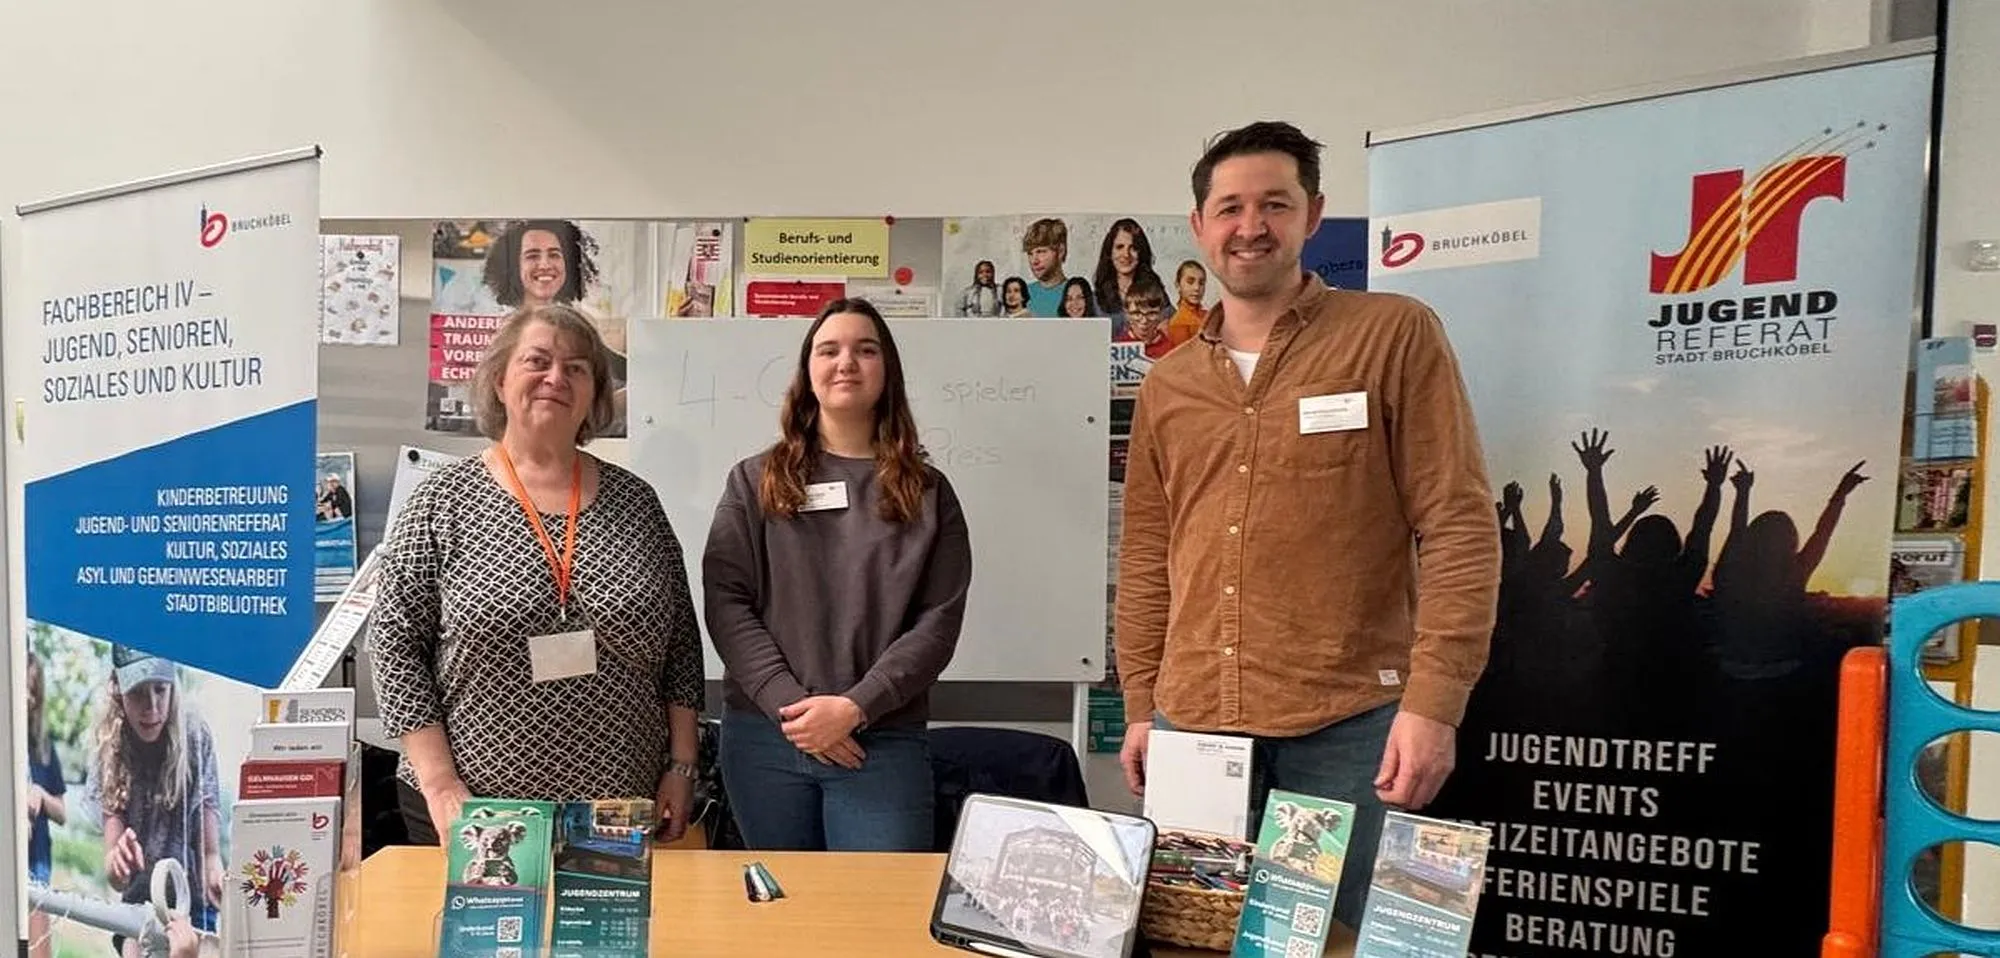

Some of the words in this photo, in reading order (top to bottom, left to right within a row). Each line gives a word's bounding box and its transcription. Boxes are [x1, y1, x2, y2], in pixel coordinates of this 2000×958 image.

[232, 214, 292, 232] BRUCHKÖBEL
[779, 232, 825, 244] Berufs-
[828, 232, 853, 244] und
[1432, 230, 1528, 251] BRUCHKÖBEL
[751, 252, 880, 267] Studienorientierung
[42, 285, 168, 326] FACHBEREICH
[175, 280, 195, 308] IV
[1648, 290, 1838, 328] JUGEND
[43, 332, 122, 363] JUGEND,
[127, 318, 234, 355] SENIOREN,
[1657, 316, 1838, 351] REFERAT
[1655, 352, 1709, 365] STADT
[1712, 342, 1833, 362] BRUCHKÖBEL
[44, 370, 128, 404] SOZIALES
[134, 366, 176, 396] UND
[182, 357, 263, 391] KULTUR
[943, 376, 1036, 404] spielen
[157, 486, 288, 507] KINDERBETREUUNG
[75, 516, 128, 534] JUGEND-
[132, 516, 159, 533] UND
[164, 513, 288, 533] SENIORENREFERAT
[166, 541, 218, 561] KULTUR,
[221, 541, 288, 559] SOZIALES
[77, 568, 107, 584] ASYL
[110, 568, 135, 584] UND
[138, 568, 288, 587] GEMEINWESENARBEIT
[166, 594, 288, 615] STADTBIBLIOTHEK
[1484, 732, 1718, 774] JUGENDTREFF
[1533, 780, 1660, 818] EVENTS
[1442, 818, 1761, 875] IZEITANGEBOTE
[560, 889, 641, 898] JUGENDZENTRUM
[1481, 866, 1711, 917] FERIENSPIELE
[1506, 913, 1676, 958] BERATUNG
